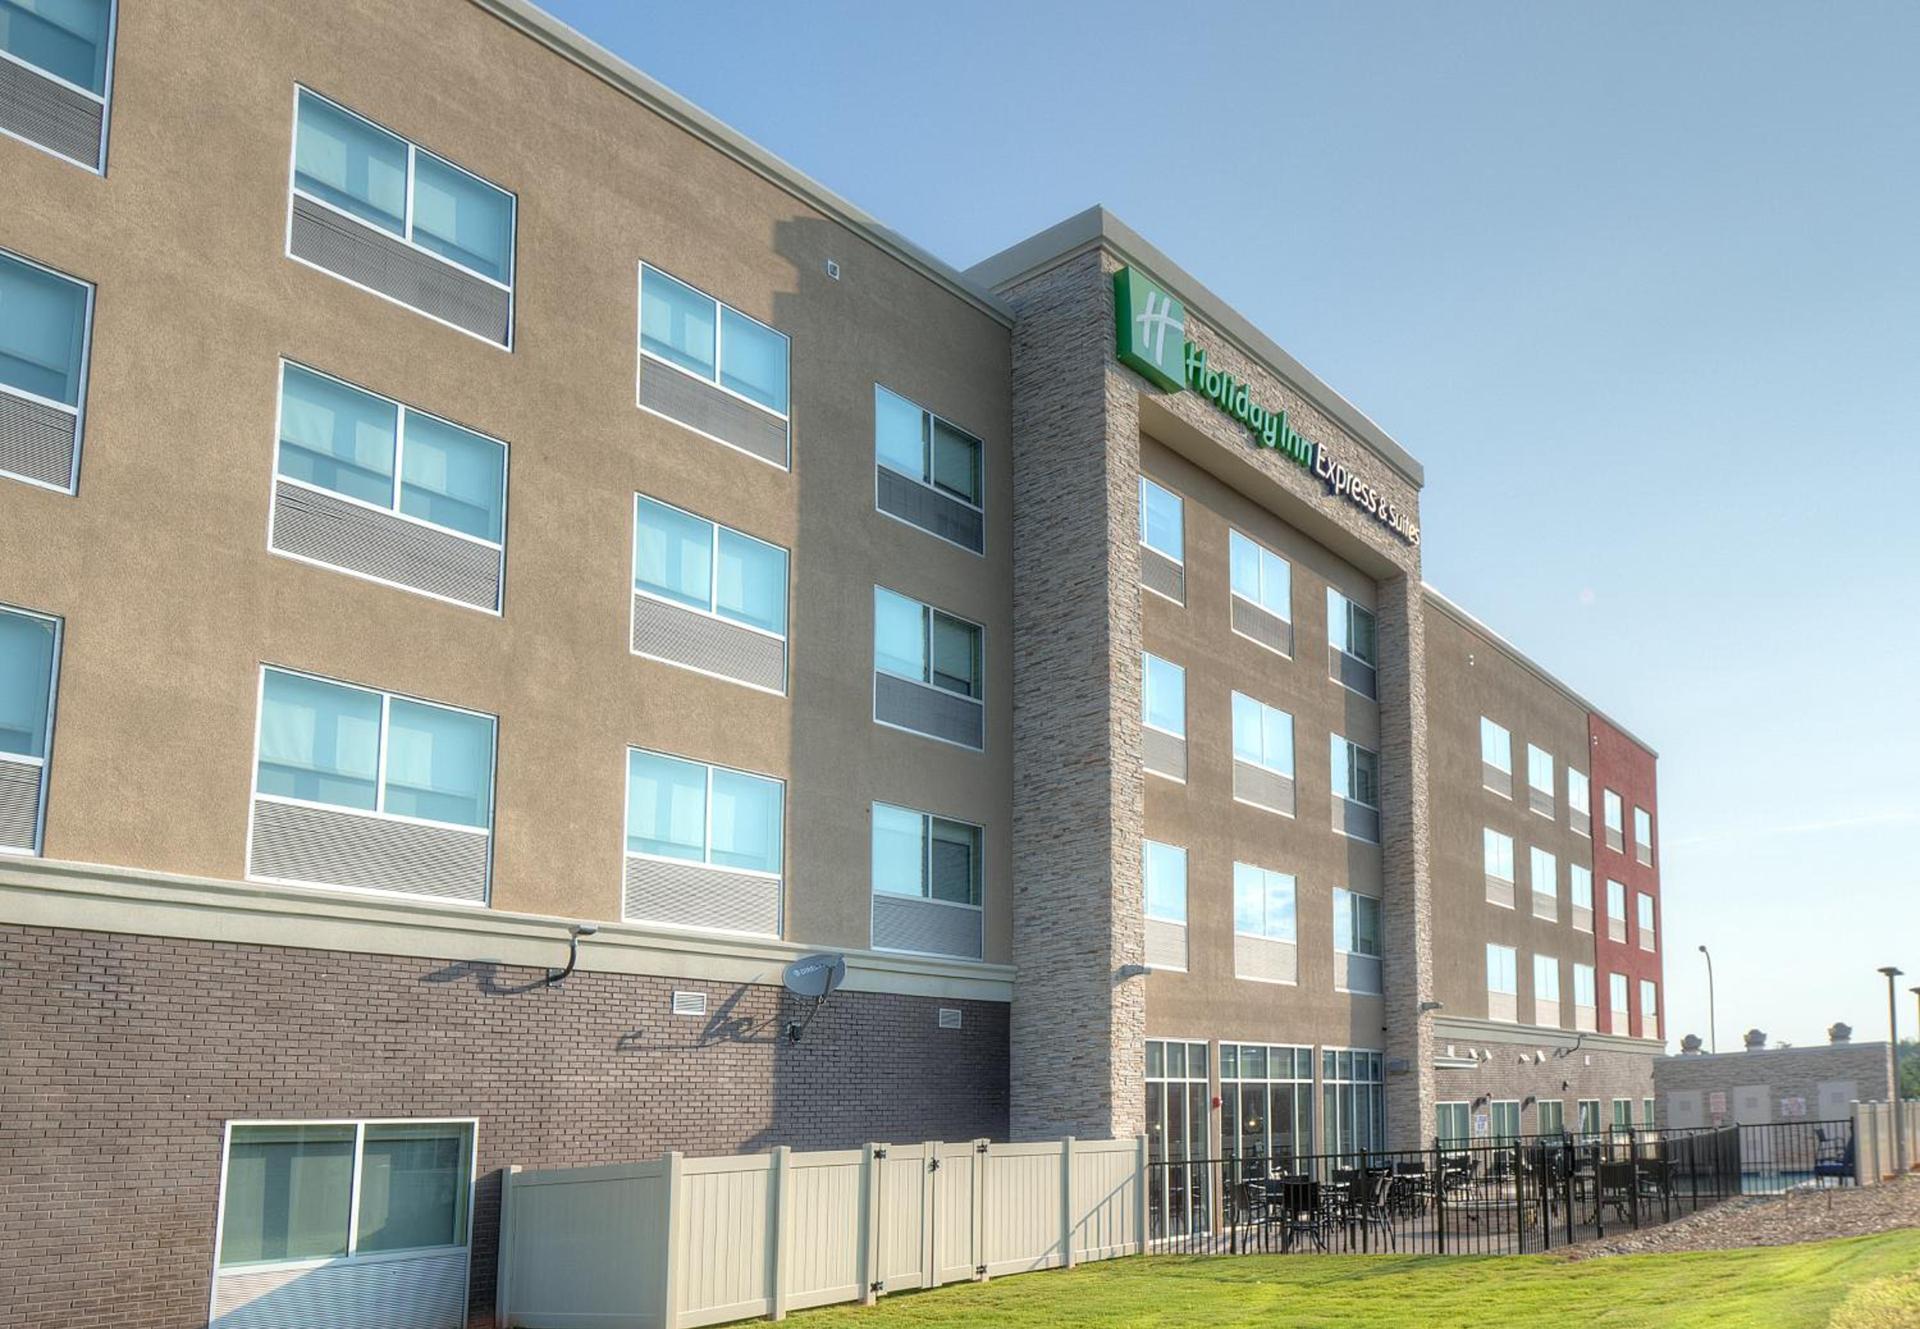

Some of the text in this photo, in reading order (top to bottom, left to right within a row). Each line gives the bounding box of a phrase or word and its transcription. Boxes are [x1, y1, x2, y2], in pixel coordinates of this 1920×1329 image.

[1186, 341, 1420, 545] Holiday Inn Express & Suites
